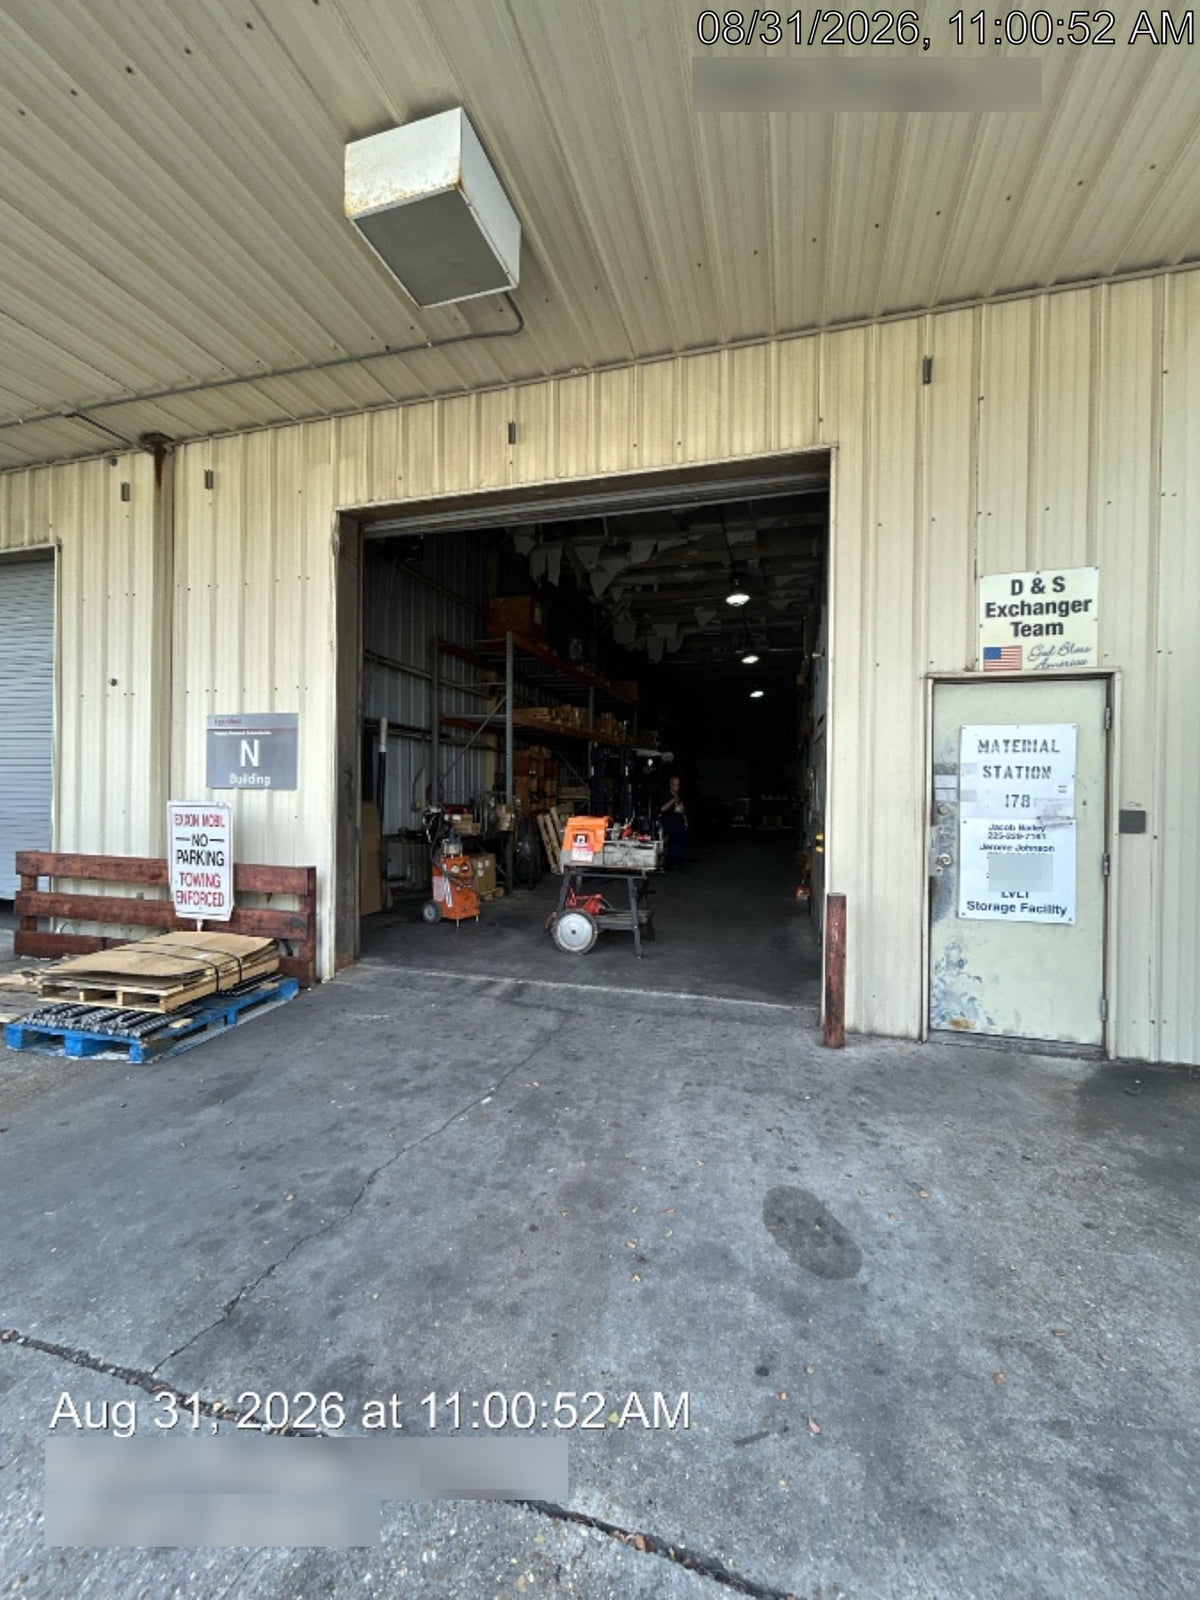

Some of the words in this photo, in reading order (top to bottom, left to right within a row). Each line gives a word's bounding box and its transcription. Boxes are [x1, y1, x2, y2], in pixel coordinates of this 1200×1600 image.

[1011, 579, 1023, 596] D
[1030, 577, 1046, 594] &
[1052, 575, 1066, 593] S
[985, 599, 1093, 618] Exchanger
[1010, 621, 1064, 637] Team
[240, 738, 259, 767] N
[977, 738, 1060, 753] MATERIAL
[982, 765, 1052, 779] STATION
[1005, 794, 1031, 808] 178
[191, 833, 208, 847] NO
[175, 849, 225, 867] PARKING
[179, 872, 221, 888] TOWING
[175, 890, 225, 908] ENFORCED
[966, 901, 1016, 914] Storage
[1020, 902, 1068, 917] Facility
